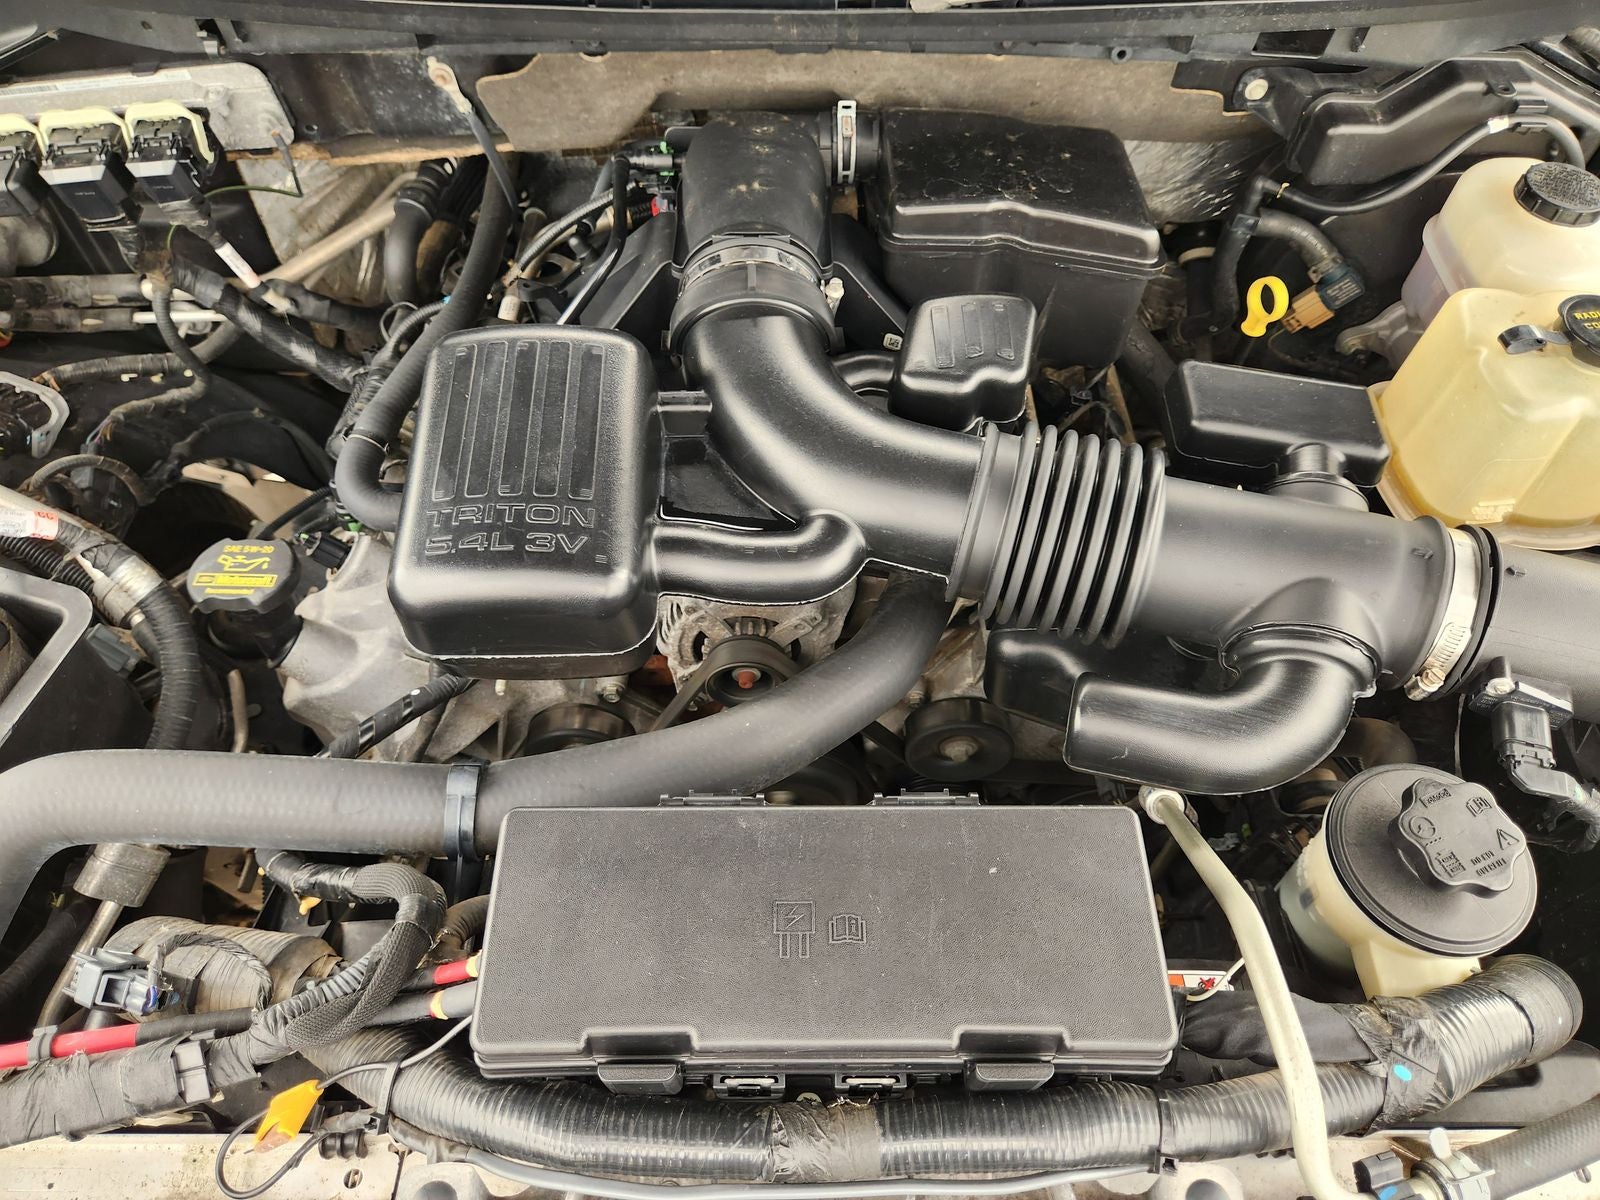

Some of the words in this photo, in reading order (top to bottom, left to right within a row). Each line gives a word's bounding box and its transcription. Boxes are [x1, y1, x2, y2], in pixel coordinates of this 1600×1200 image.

[1583, 321, 1600, 329] CO
[426, 503, 595, 528] TRITON
[425, 531, 514, 554] 5.4L
[524, 532, 588, 554] 3V
